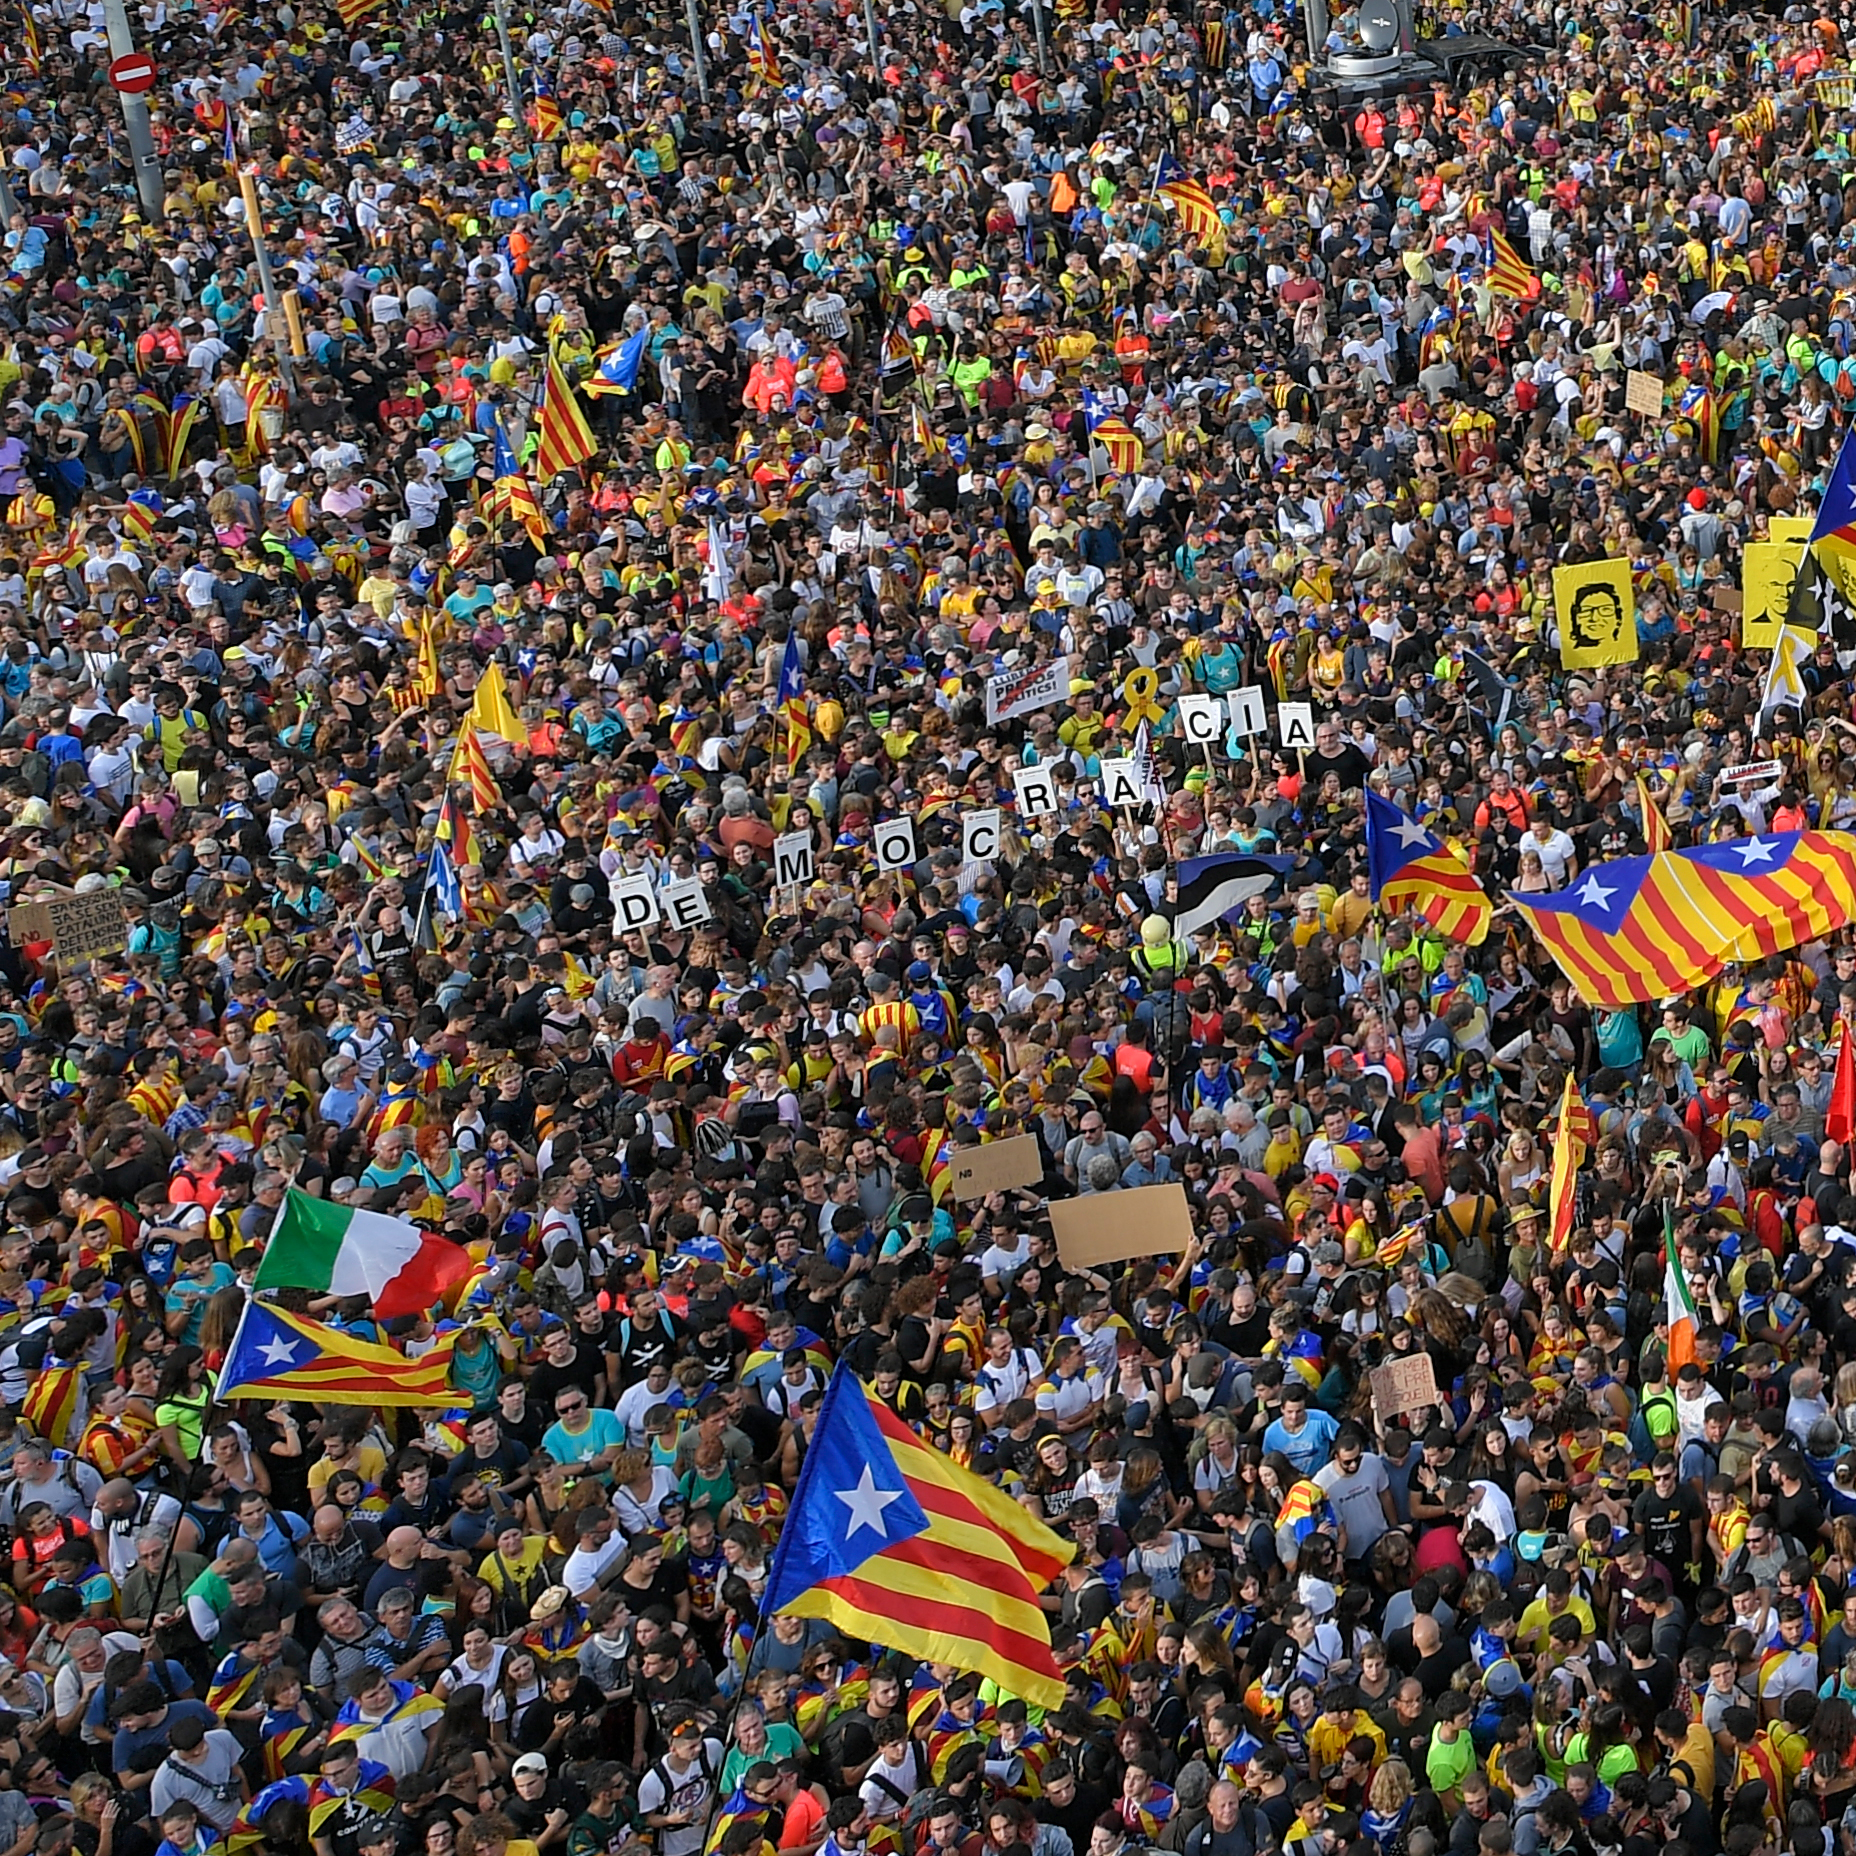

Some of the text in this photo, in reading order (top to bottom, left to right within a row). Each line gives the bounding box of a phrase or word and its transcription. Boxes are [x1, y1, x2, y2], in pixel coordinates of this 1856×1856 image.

[995, 670, 1055, 699] PREOS
[50, 891, 118, 914] JA RESSONA
[52, 912, 73, 926] JA
[76, 909, 91, 919] SE
[56, 910, 124, 937] CATALUNYA
[20, 930, 40, 943] NO
[59, 922, 127, 949] DEFENSADA
[59, 945, 85, 959] PER
[959, 1169, 973, 1180] NO
